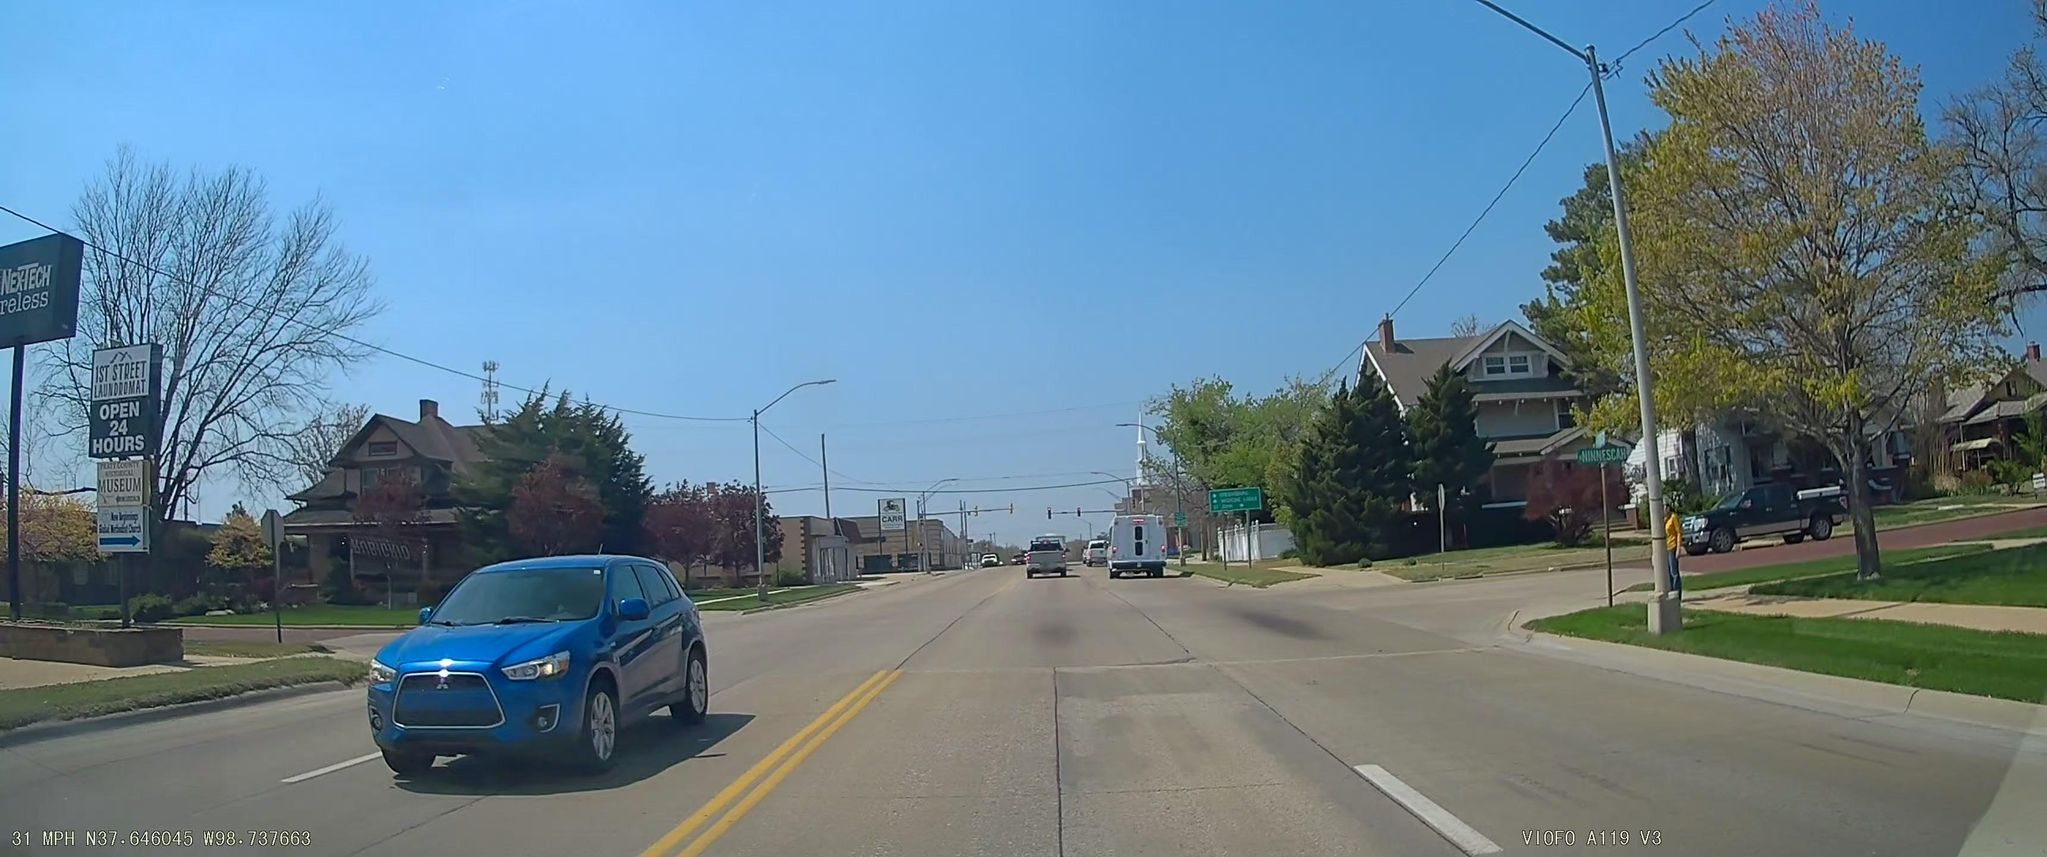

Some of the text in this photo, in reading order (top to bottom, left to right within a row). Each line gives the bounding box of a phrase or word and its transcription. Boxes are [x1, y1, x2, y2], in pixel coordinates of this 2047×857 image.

[95, 361, 147, 383] 1ST STREET
[94, 379, 146, 398] LAUNDROMAT
[100, 401, 140, 420] OPEN
[109, 419, 128, 436] 24
[93, 435, 145, 454] HOURS
[1582, 447, 1627, 462] NINNESCAH
[99, 477, 141, 493] MUSEUM
